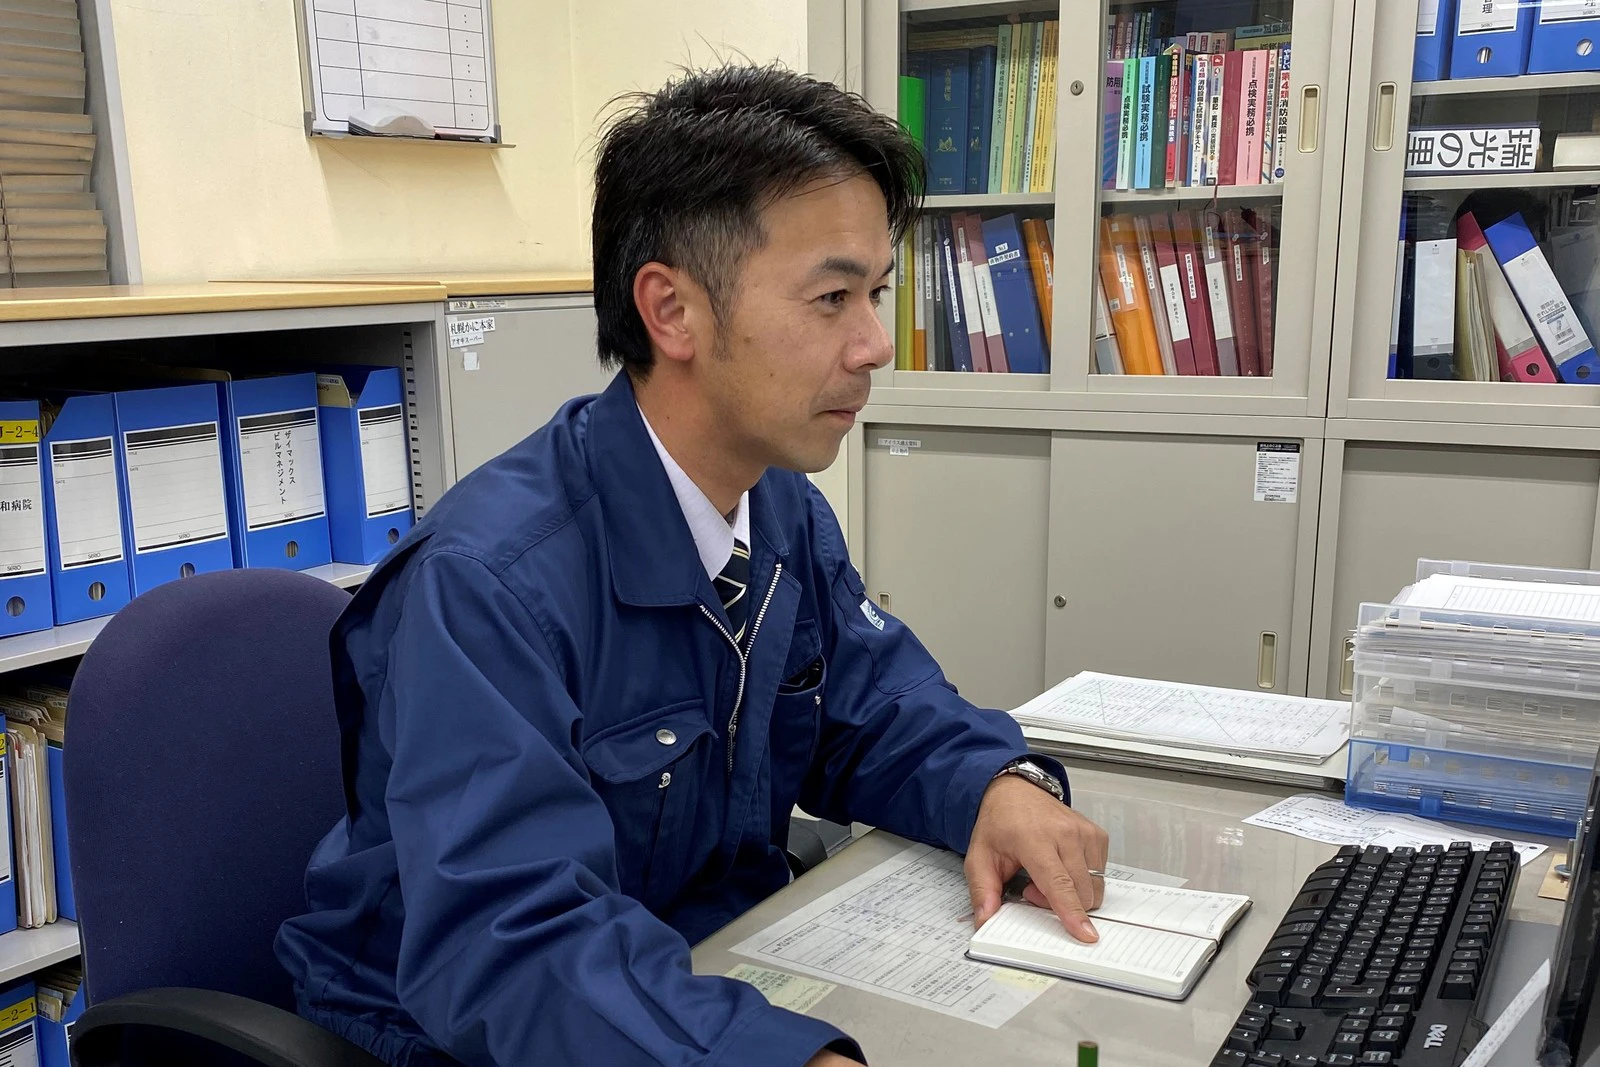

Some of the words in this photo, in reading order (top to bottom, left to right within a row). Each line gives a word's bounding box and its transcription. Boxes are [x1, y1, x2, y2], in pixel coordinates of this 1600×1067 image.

[1106, 77, 1124, 88] 防用
[1140, 84, 1150, 142] 試験実務必携
[1246, 80, 1258, 136] 点検実務必携
[1407, 130, 1533, 168] 瑞光の里
[451, 318, 494, 334] 札幌かに本家
[274, 432, 286, 504] ビルマネジメント
[285, 430, 295, 484] ザイマックス
[0, 498, 32, 512] 和病院
[1, 1002, 35, 1022] -2-1
[1423, 1024, 1448, 1048] DELL
